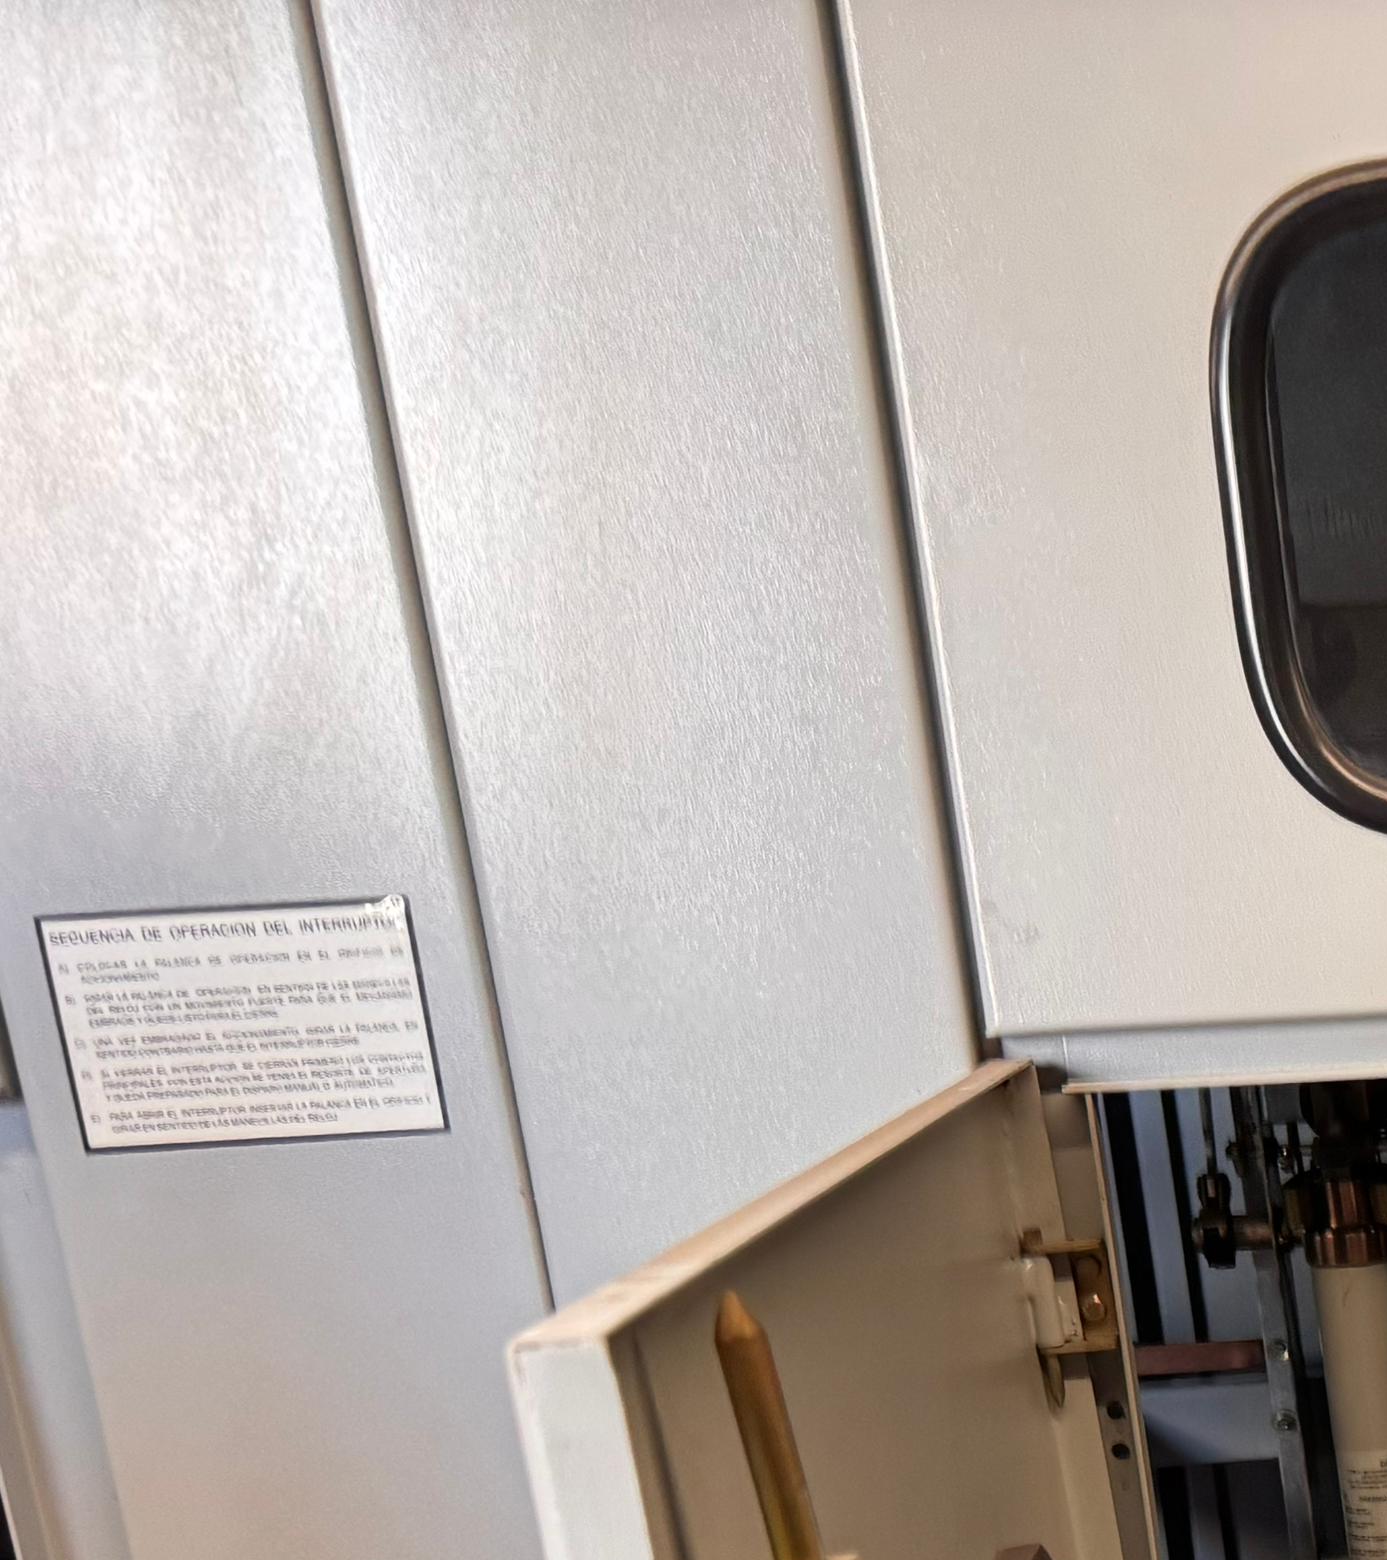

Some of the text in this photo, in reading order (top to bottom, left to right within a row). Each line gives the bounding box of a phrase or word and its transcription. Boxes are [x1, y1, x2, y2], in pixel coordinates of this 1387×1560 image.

[141, 926, 162, 942] DE
[169, 920, 257, 941] OPERACION
[264, 919, 293, 936] DEL
